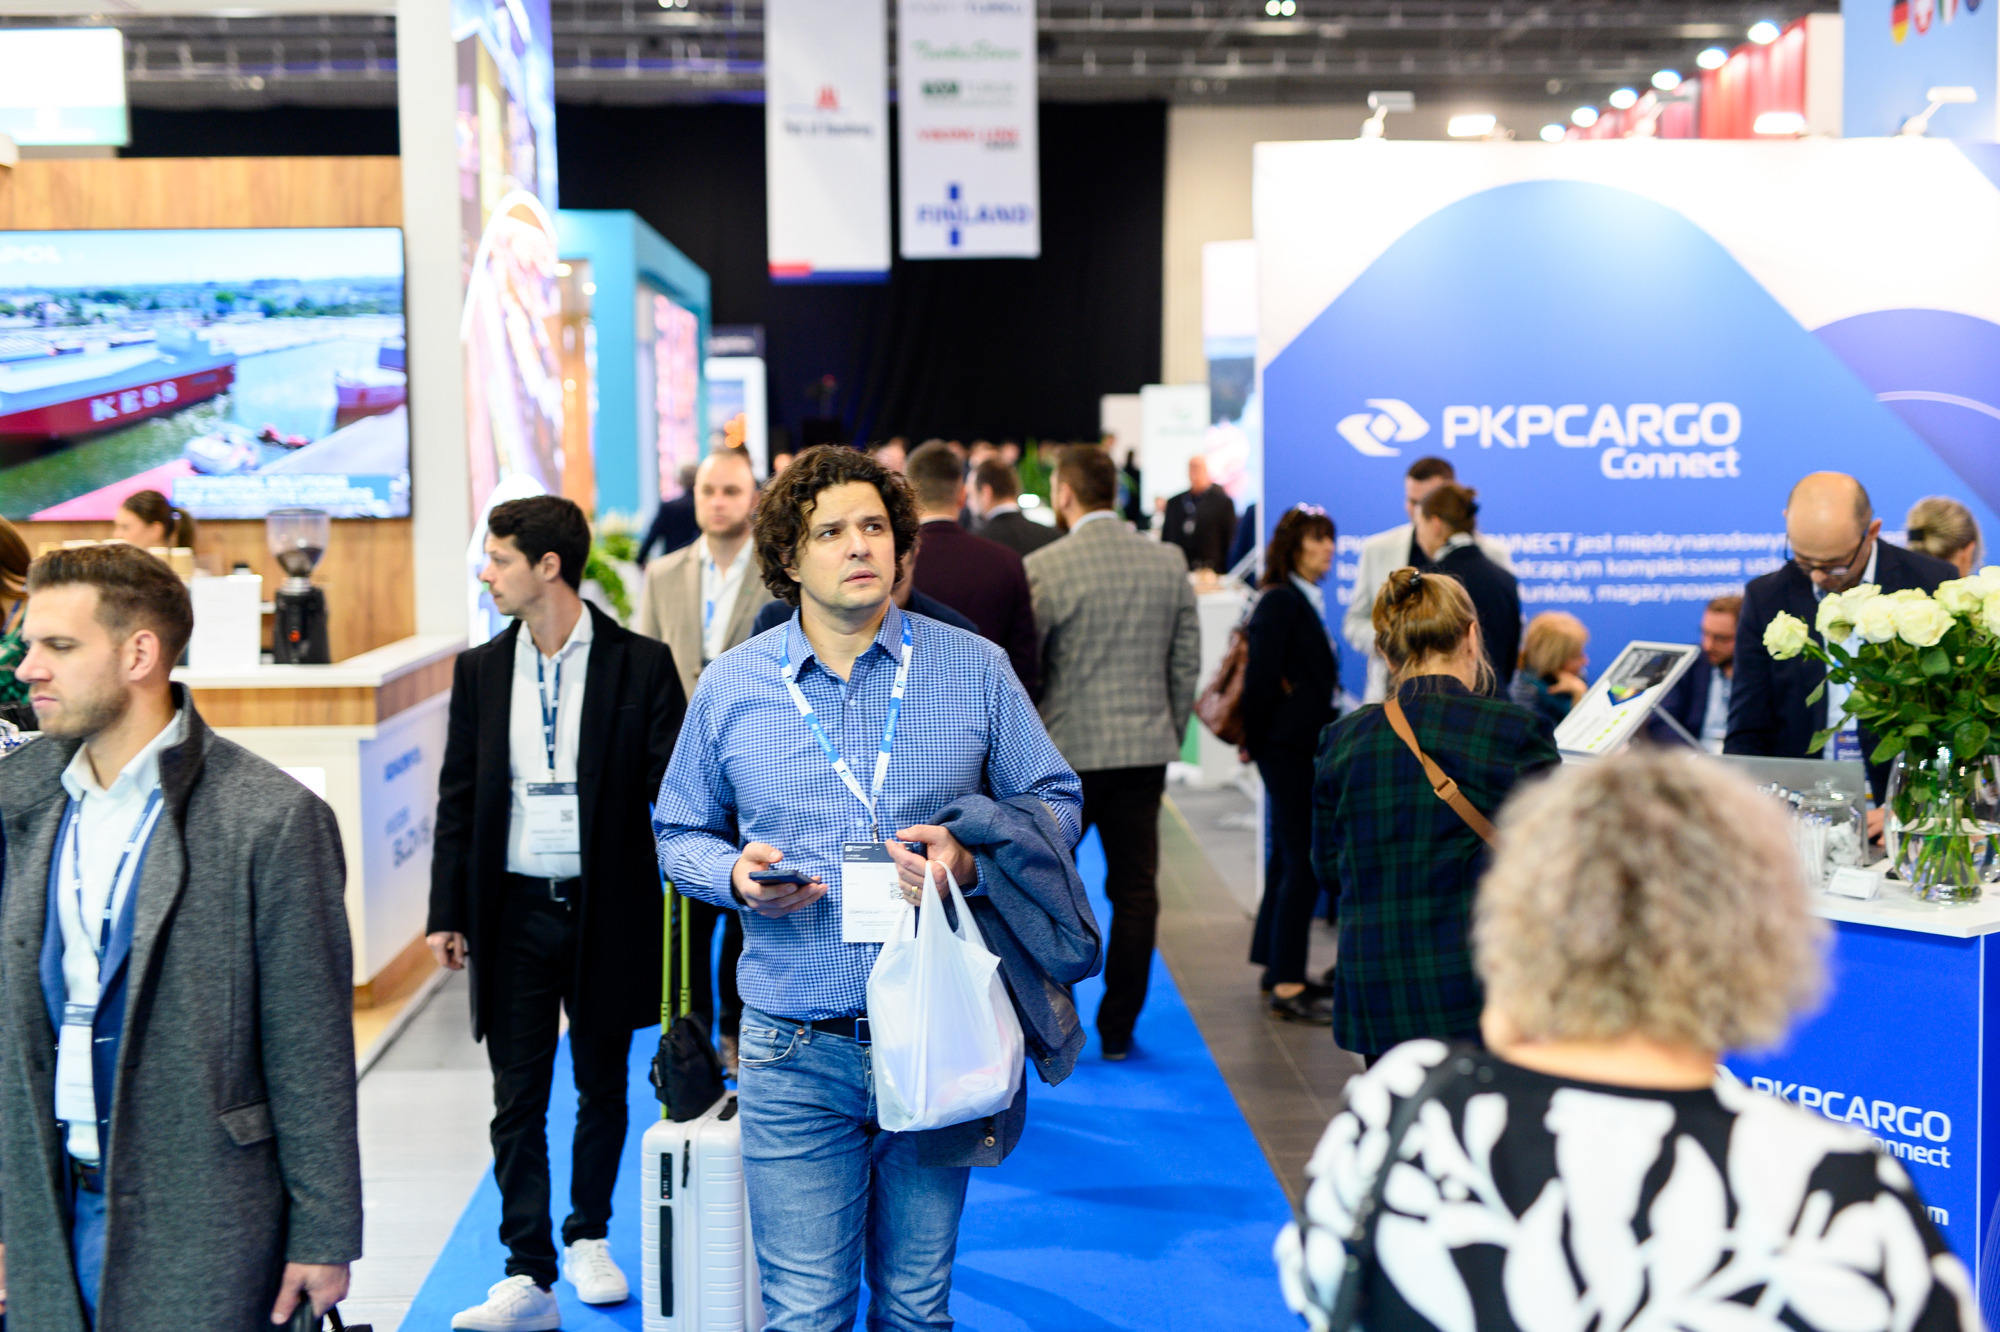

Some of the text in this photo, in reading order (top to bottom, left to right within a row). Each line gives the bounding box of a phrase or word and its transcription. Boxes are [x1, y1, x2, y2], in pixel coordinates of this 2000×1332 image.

[917, 203, 1031, 226] FINLAND
[90, 380, 178, 423] KESS
[1601, 447, 1741, 479] Connect
[1573, 531, 1613, 558] jest
[1604, 556, 1741, 580] kompleksowe
[1857, 1129, 1951, 1168] onnect
